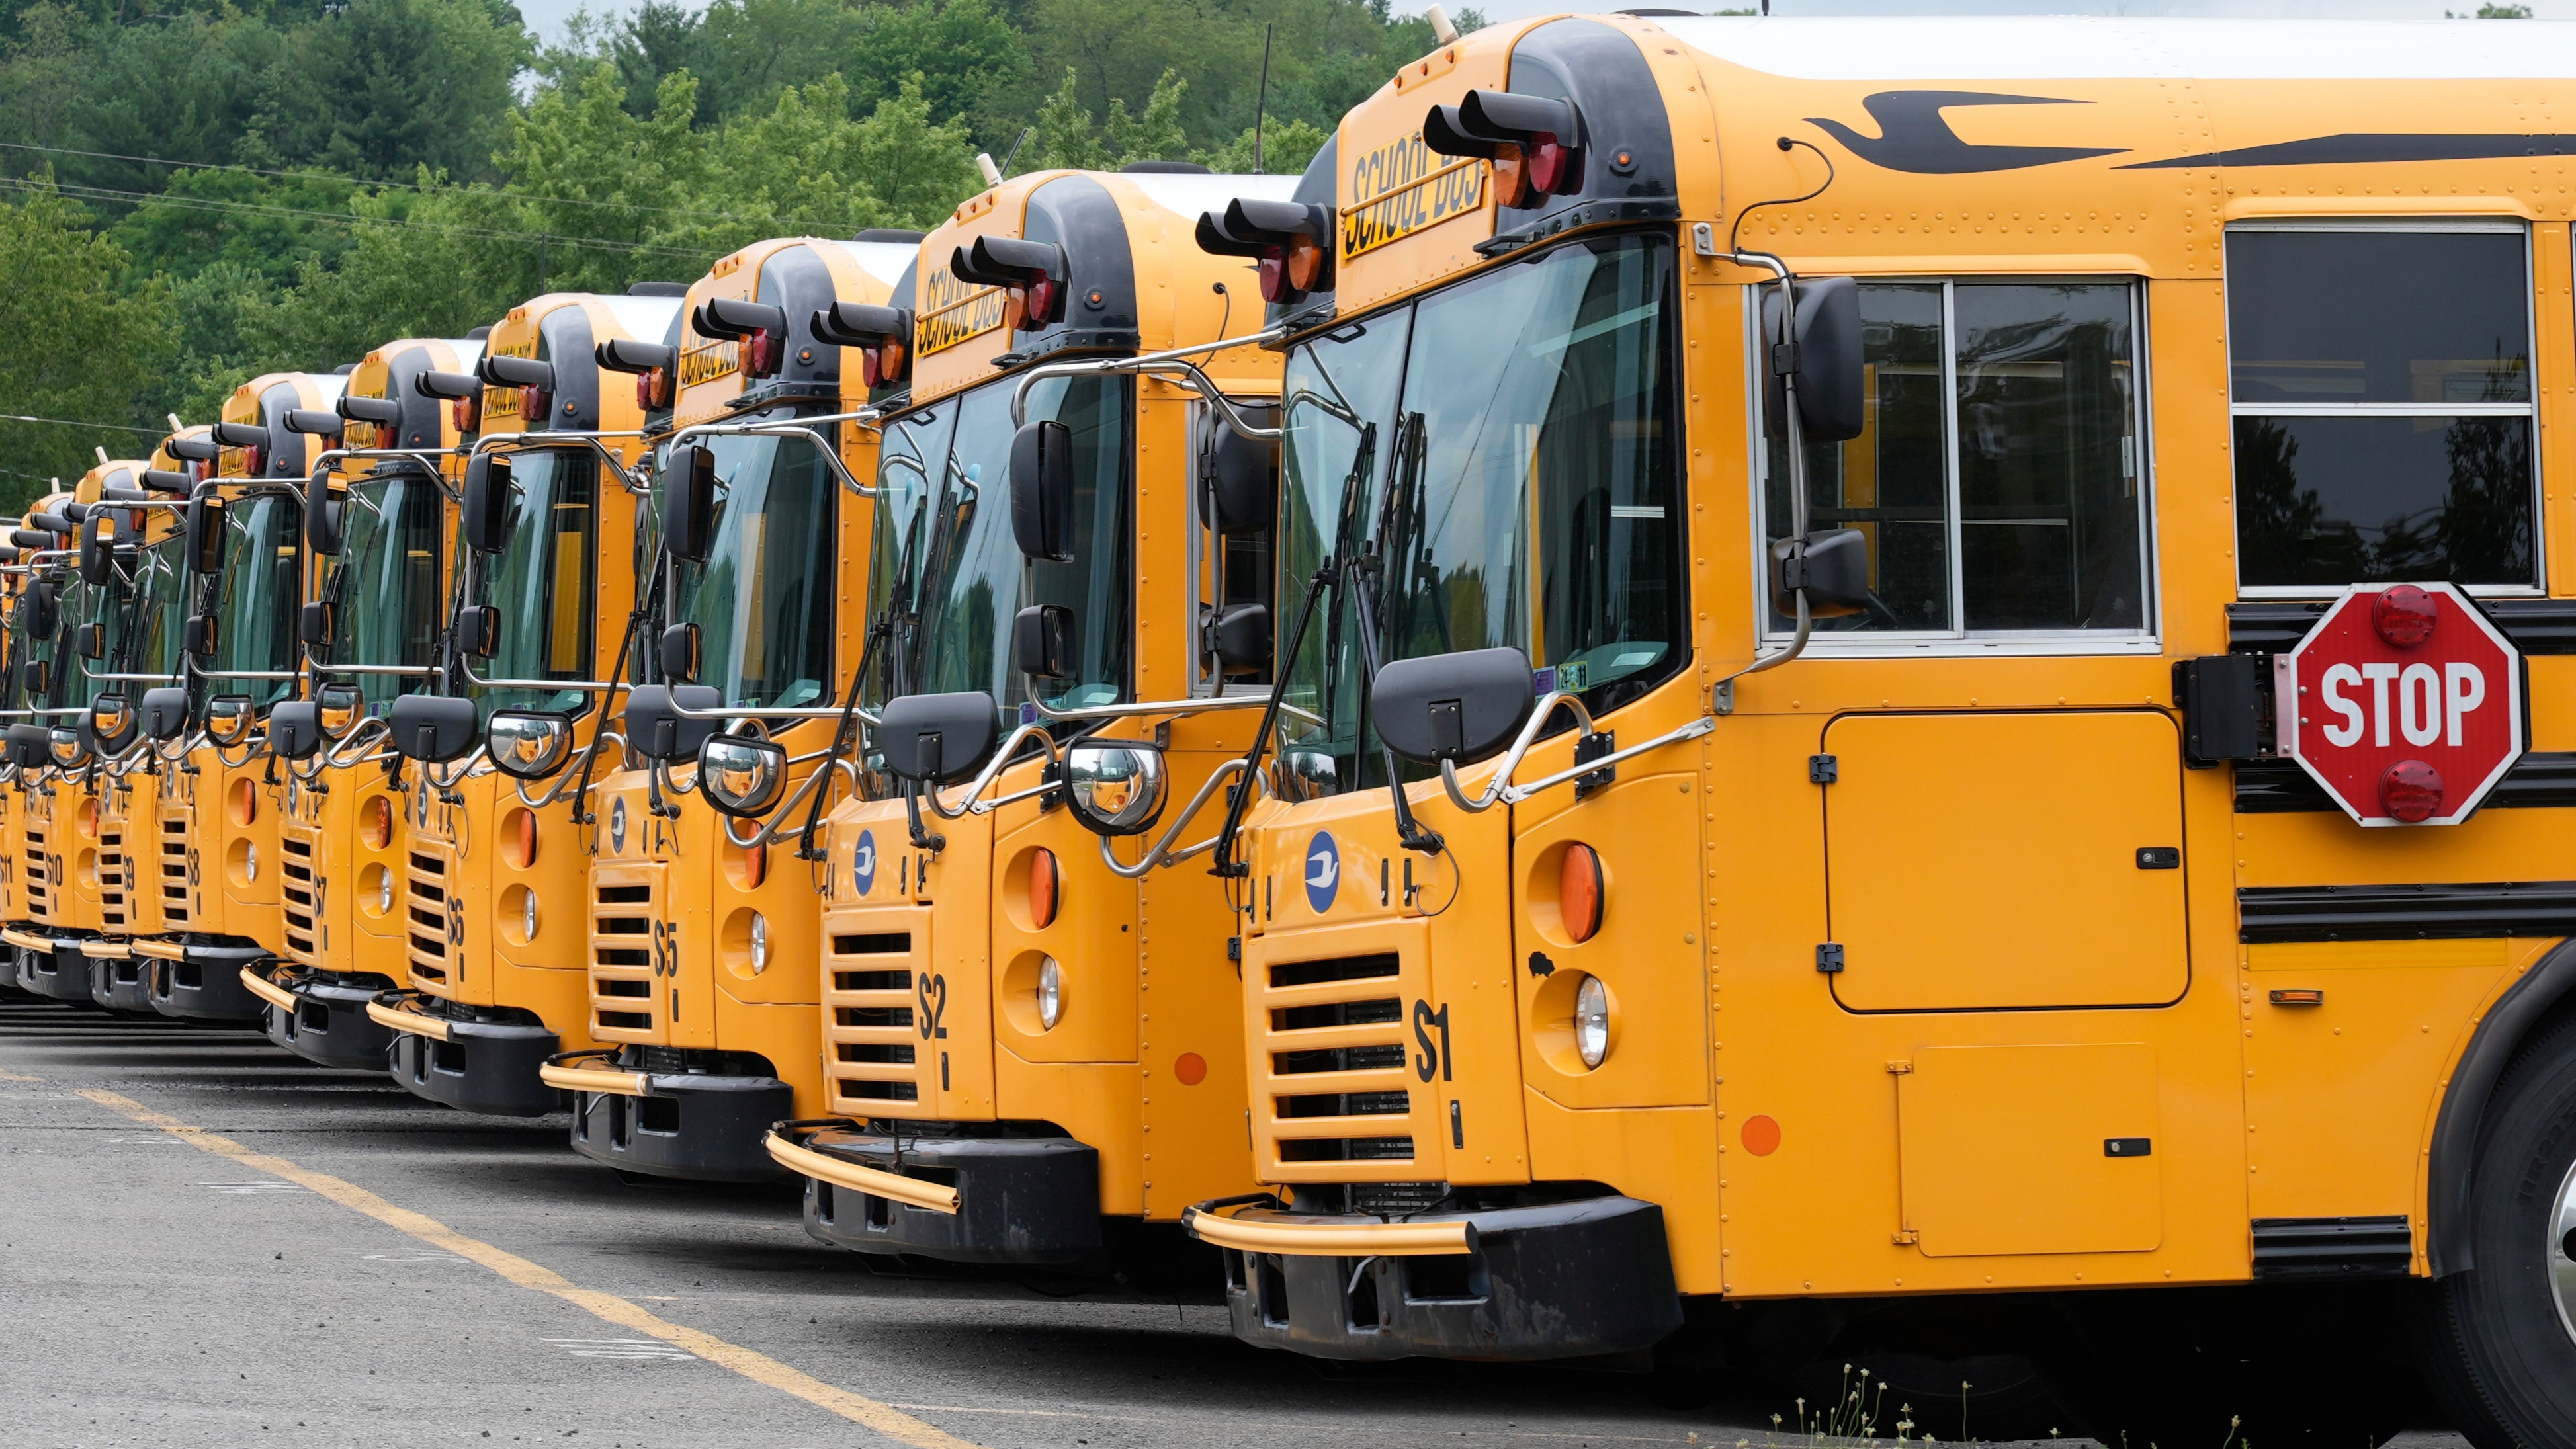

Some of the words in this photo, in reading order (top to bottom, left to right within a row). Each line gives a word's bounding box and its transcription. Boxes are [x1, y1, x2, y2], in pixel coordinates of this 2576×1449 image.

[1345, 130, 1428, 255] SCHOOL
[918, 269, 971, 354] SCHOOL
[2321, 662, 2485, 747] STOP
[46, 852, 63, 887] S10
[187, 847, 200, 887] S8
[314, 874, 327, 919] S7
[447, 895, 464, 946] S6
[654, 919, 677, 977] S5
[919, 972, 947, 1040] S2
[1413, 999, 1452, 1083] S1
